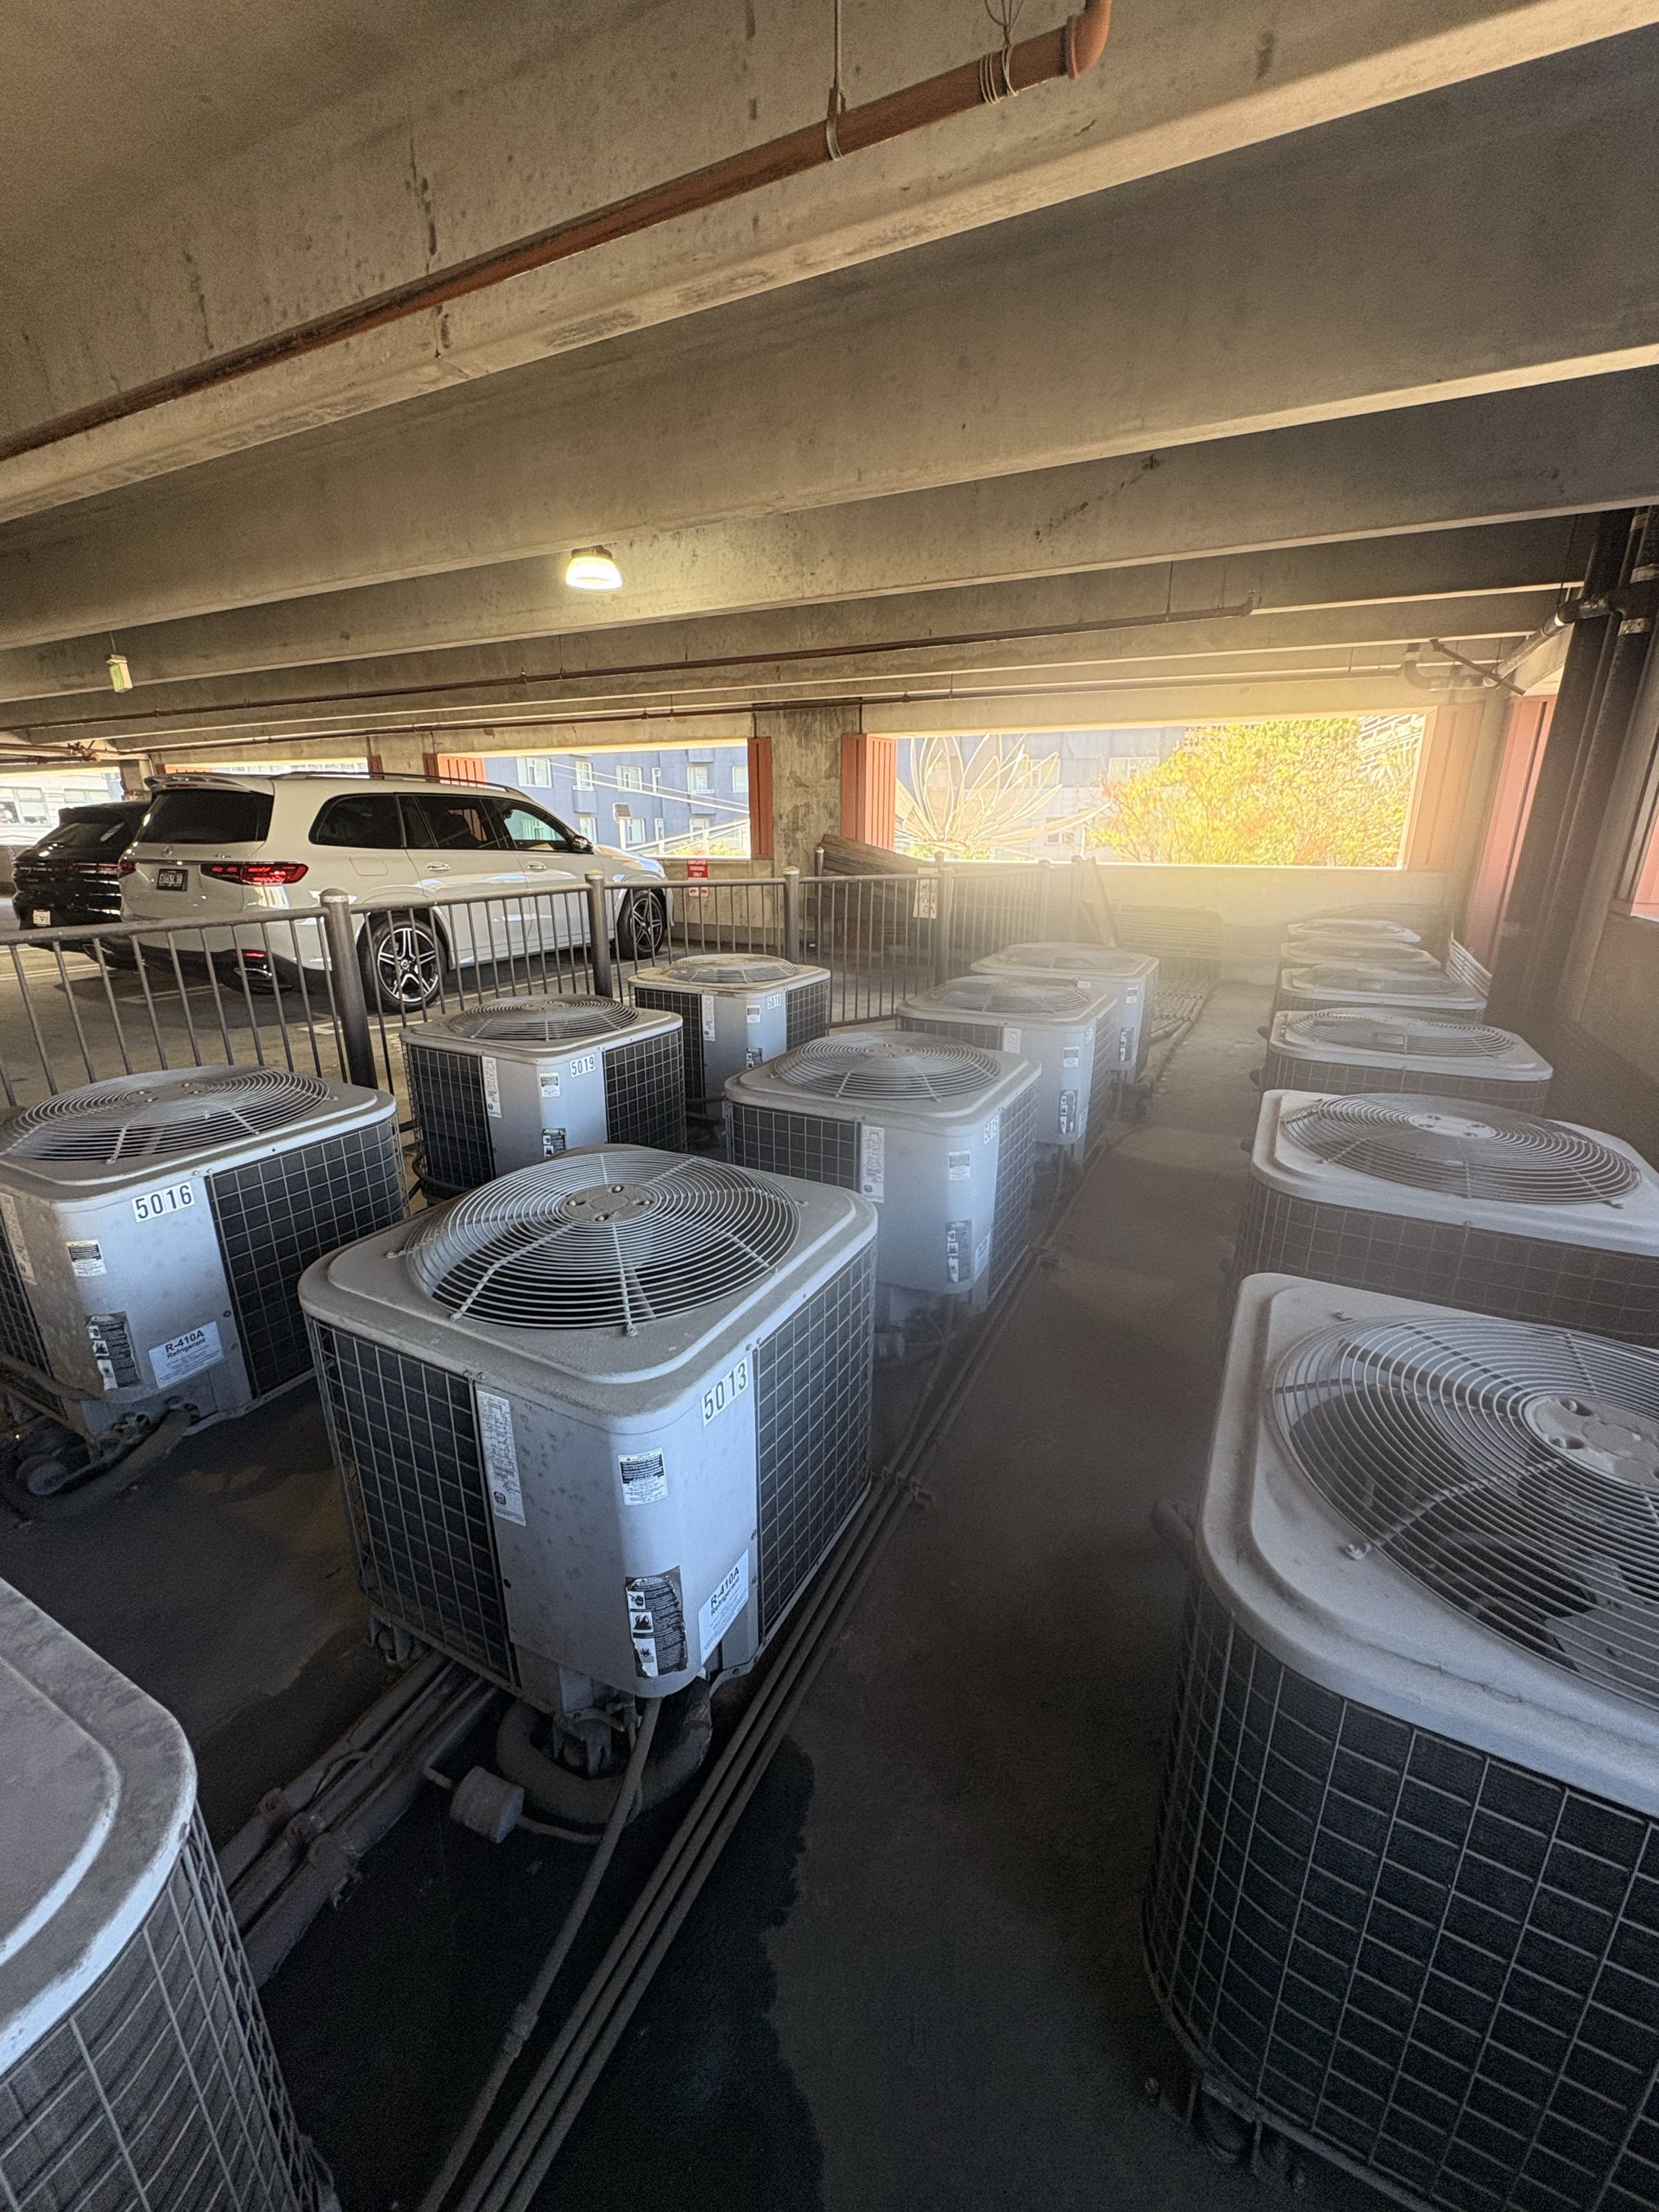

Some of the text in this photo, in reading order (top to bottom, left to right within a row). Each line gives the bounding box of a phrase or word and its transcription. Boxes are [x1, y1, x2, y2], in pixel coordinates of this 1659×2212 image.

[768, 995, 781, 1008] 5018
[571, 1056, 595, 1075] 5019
[135, 1185, 192, 1220] 5016
[165, 1330, 205, 1353] R-410A
[167, 1337, 207, 1359] Refrigerant
[704, 1362, 747, 1420] 5013
[710, 1567, 740, 1608] R-410A
[711, 1576, 740, 1617] Refrigerant
